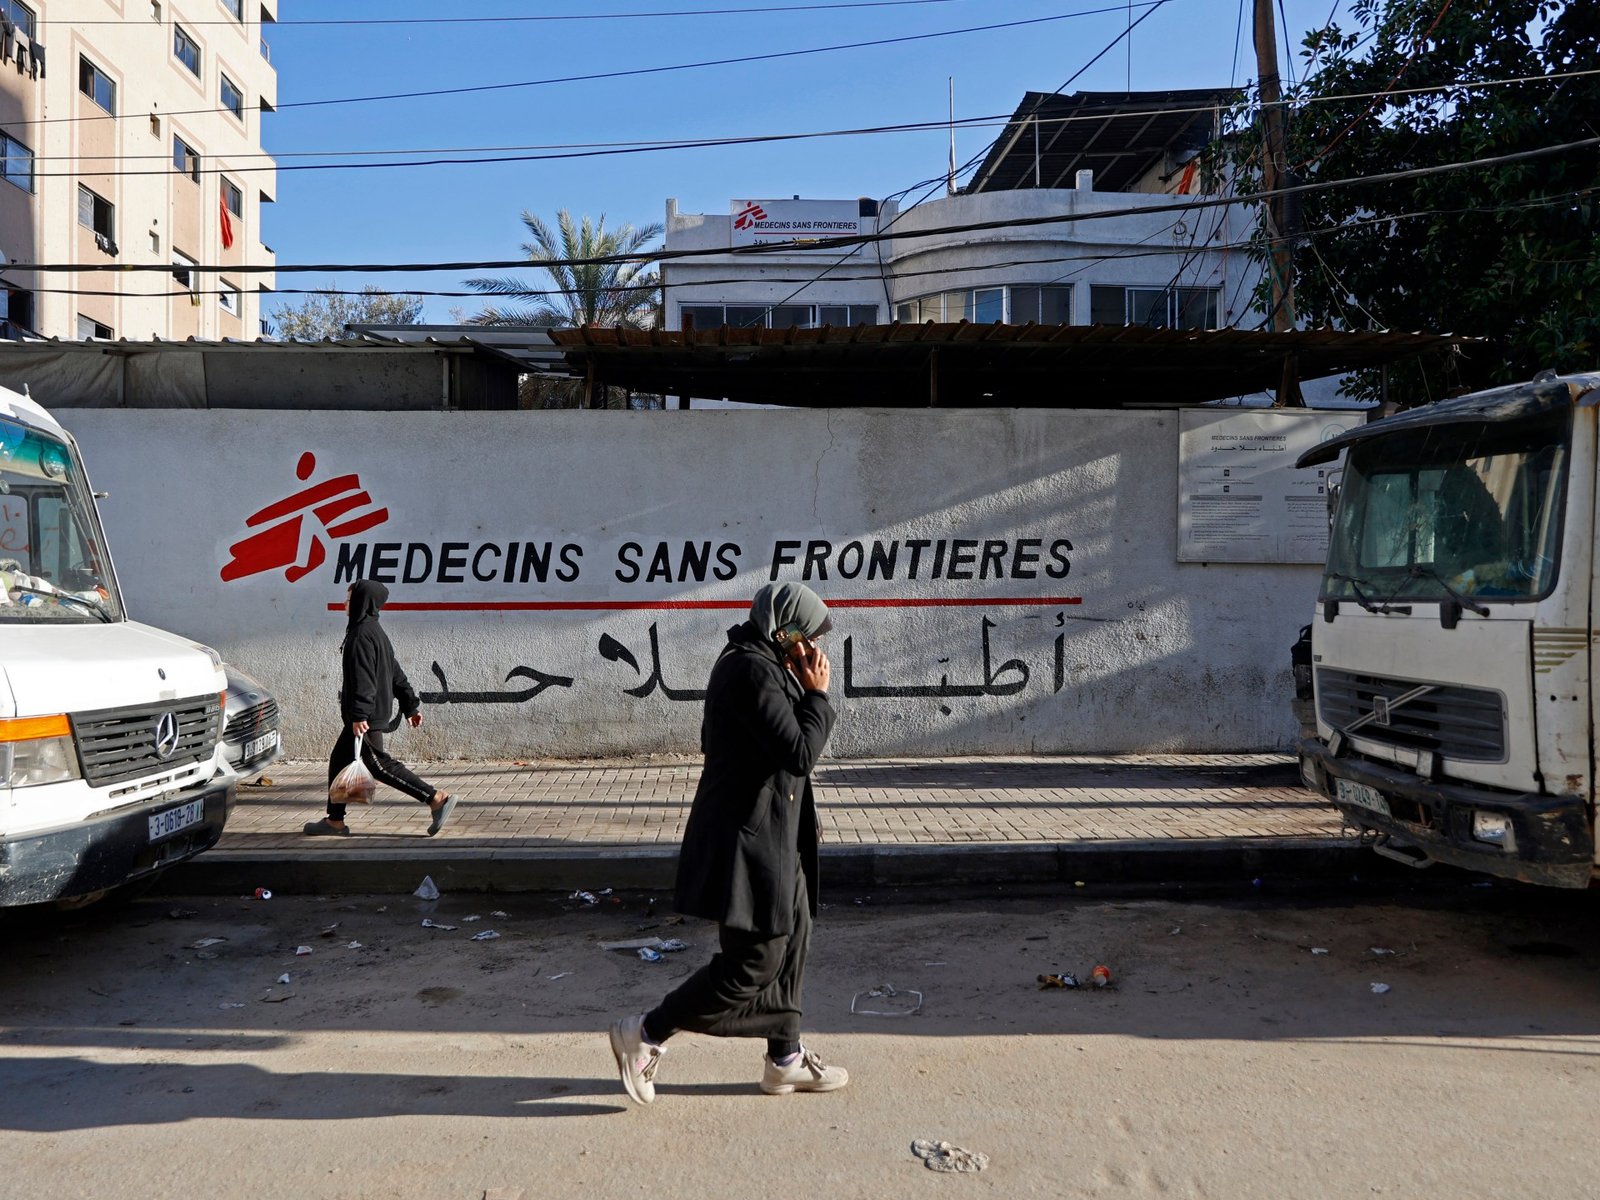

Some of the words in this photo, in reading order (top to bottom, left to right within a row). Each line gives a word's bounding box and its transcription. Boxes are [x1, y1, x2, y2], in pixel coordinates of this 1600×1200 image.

[754, 221, 791, 229] MEDECINS
[792, 221, 811, 229] SANS
[813, 221, 857, 229] FRONTIERES
[334, 542, 583, 584] MEDECINS
[615, 540, 742, 583] SANS
[769, 539, 1074, 582] FRONTIERES
